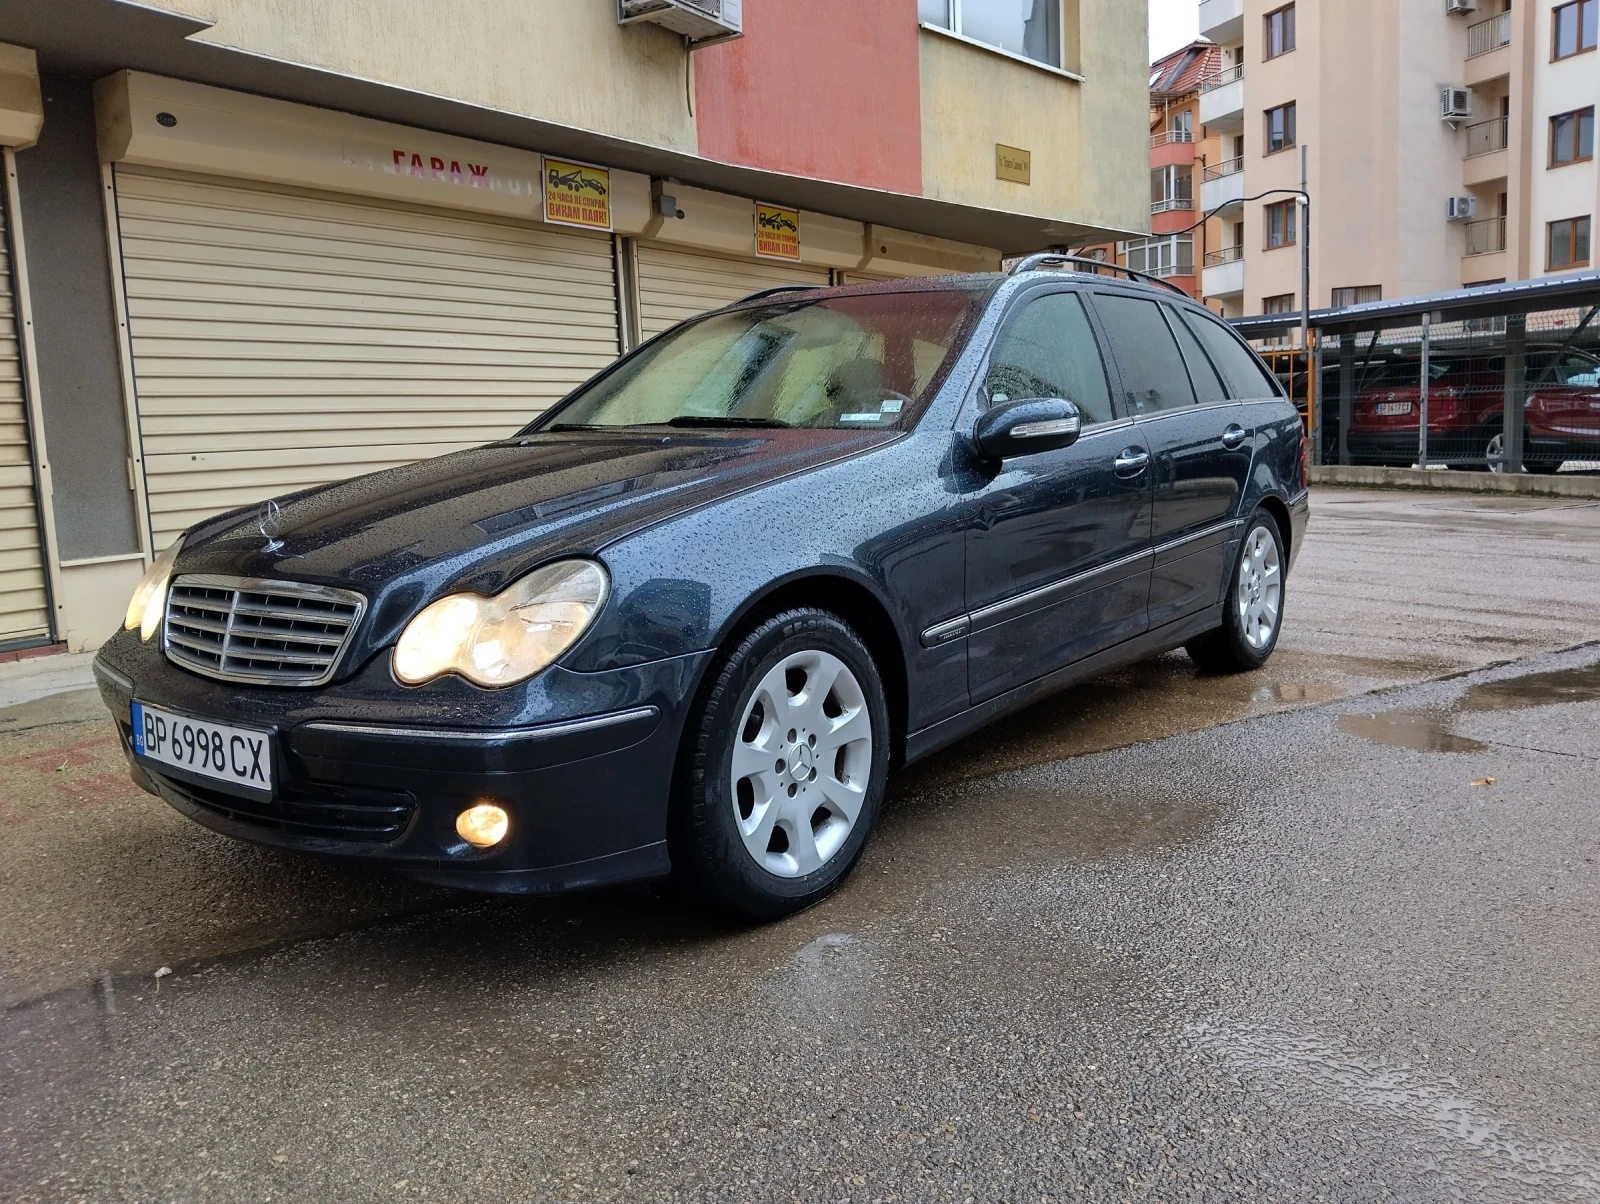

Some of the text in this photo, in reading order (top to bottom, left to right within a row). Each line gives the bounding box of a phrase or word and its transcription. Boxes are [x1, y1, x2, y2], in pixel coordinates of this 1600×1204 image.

[392, 149, 490, 189] ГАРАЖ
[548, 191, 556, 201] 24
[557, 192, 573, 204] ЧАСА
[574, 195, 582, 205] НЕ
[549, 202, 607, 224] ВИКАМ ПАЯК!
[759, 240, 781, 253] ВИКАМ
[144, 711, 266, 783] BP 6998 CX
